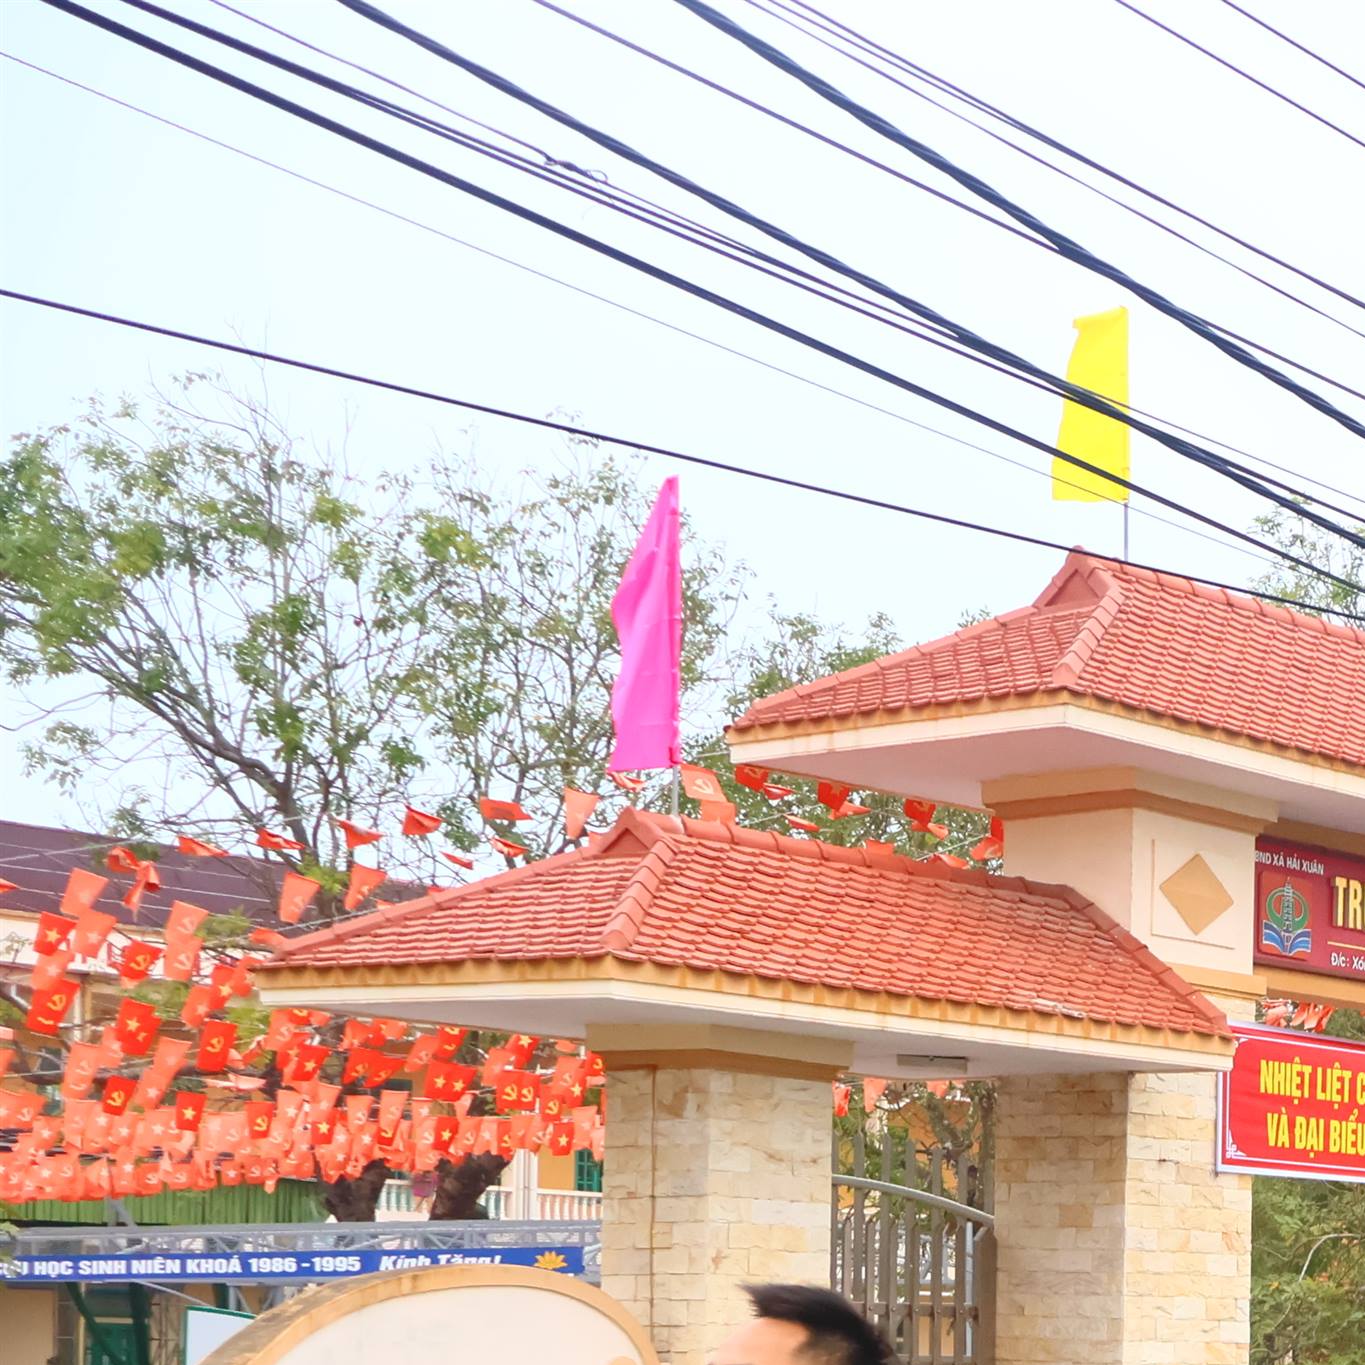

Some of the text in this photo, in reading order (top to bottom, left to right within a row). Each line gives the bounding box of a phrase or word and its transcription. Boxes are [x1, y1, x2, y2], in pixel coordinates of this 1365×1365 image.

[1254, 850, 1272, 865] BND
[1286, 853, 1301, 871] HẢI
[1301, 859, 1324, 875] XUÂN
[1259, 1056, 1312, 1105] NHIỆT
[1316, 1061, 1353, 1110] LIỆT
[1266, 1107, 1290, 1149] VÀ
[1294, 1115, 1324, 1158] ĐẠI
[34, 1260, 73, 1278] HỌC
[78, 1259, 127, 1275] SINH
[131, 1256, 180, 1275] NIÊN
[185, 1255, 242, 1274] KHOÁ
[248, 1257, 297, 1273] 1986
